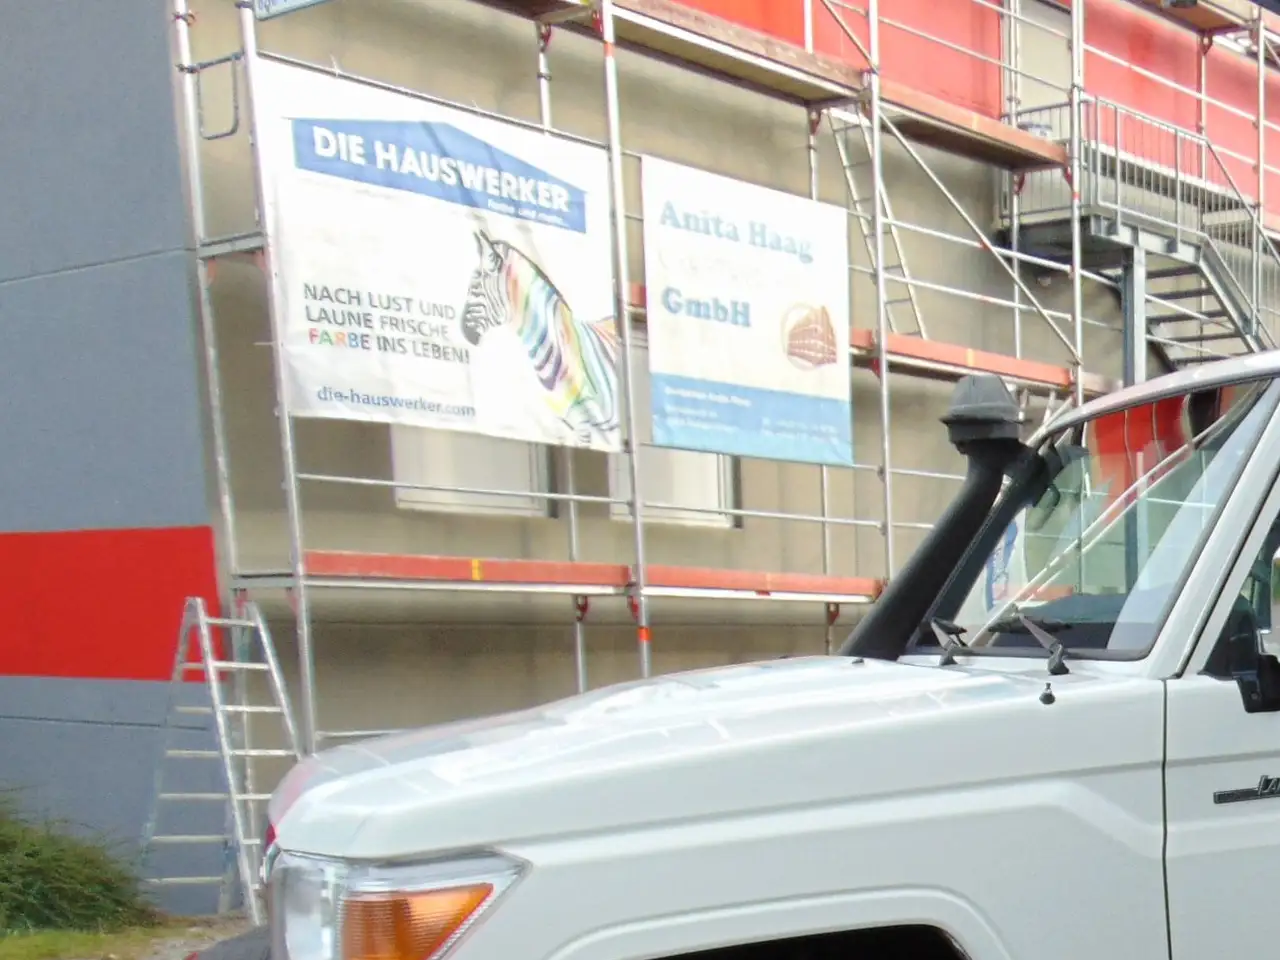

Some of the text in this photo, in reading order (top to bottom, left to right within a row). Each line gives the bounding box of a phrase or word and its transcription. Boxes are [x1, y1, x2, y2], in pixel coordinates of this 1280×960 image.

[312, 125, 570, 212] DIE HAUSWERKER
[659, 200, 815, 264] Anita Haag
[303, 282, 456, 321] NACH LUST UND
[661, 286, 752, 328] GmbH
[305, 305, 450, 340] LAUNE FRISCHE
[308, 327, 471, 365] FARBE INS LEBEN!
[316, 385, 477, 417] die-hauswerker.com
